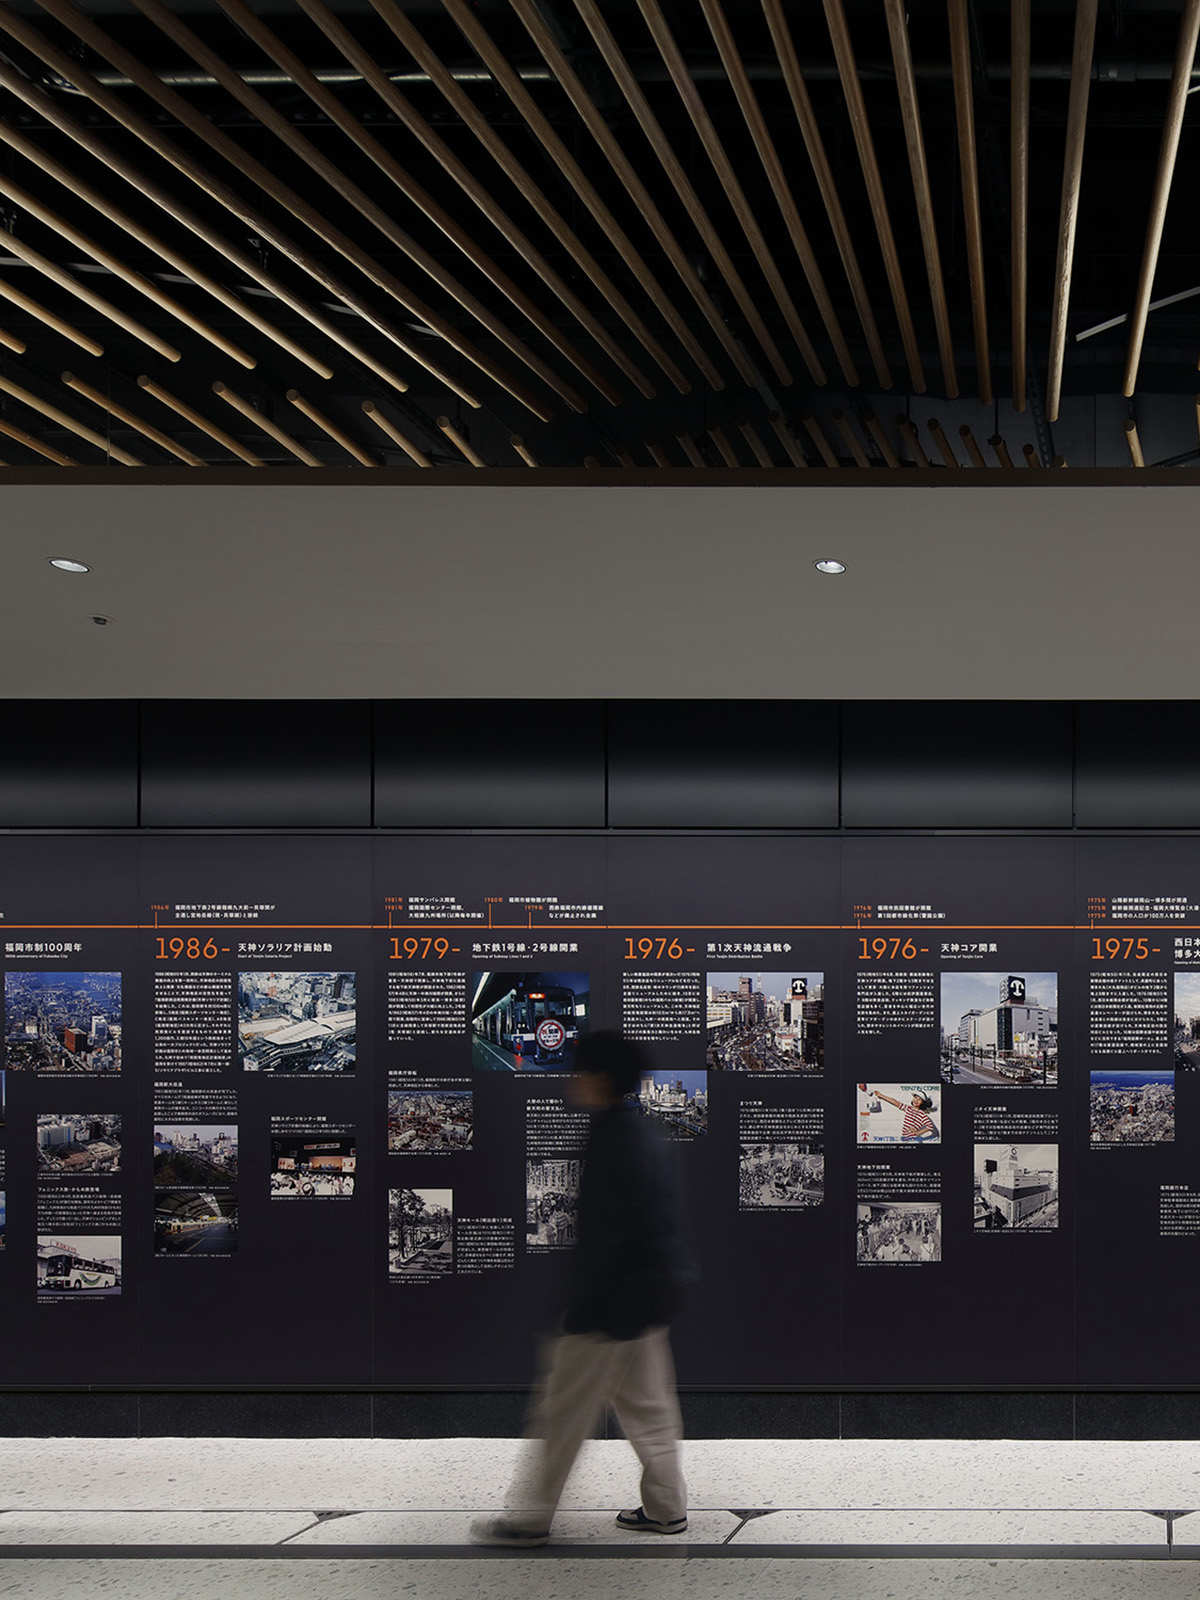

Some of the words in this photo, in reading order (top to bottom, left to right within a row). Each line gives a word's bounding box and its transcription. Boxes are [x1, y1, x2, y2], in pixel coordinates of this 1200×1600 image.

[5, 943, 82, 952] 福岡市制100周年
[156, 938, 230, 959] 1986-
[238, 943, 332, 952] 天神ソラリア計画始動
[390, 938, 460, 959] 1979-
[473, 943, 578, 952] 地下鉄1号線・2号線開業
[625, 938, 695, 959] 1976-
[707, 943, 791, 952] 第1次天神流通戦争
[859, 938, 929, 959] 1976-
[941, 943, 997, 952] 天神コア開業
[1092, 938, 1160, 959] 1975-
